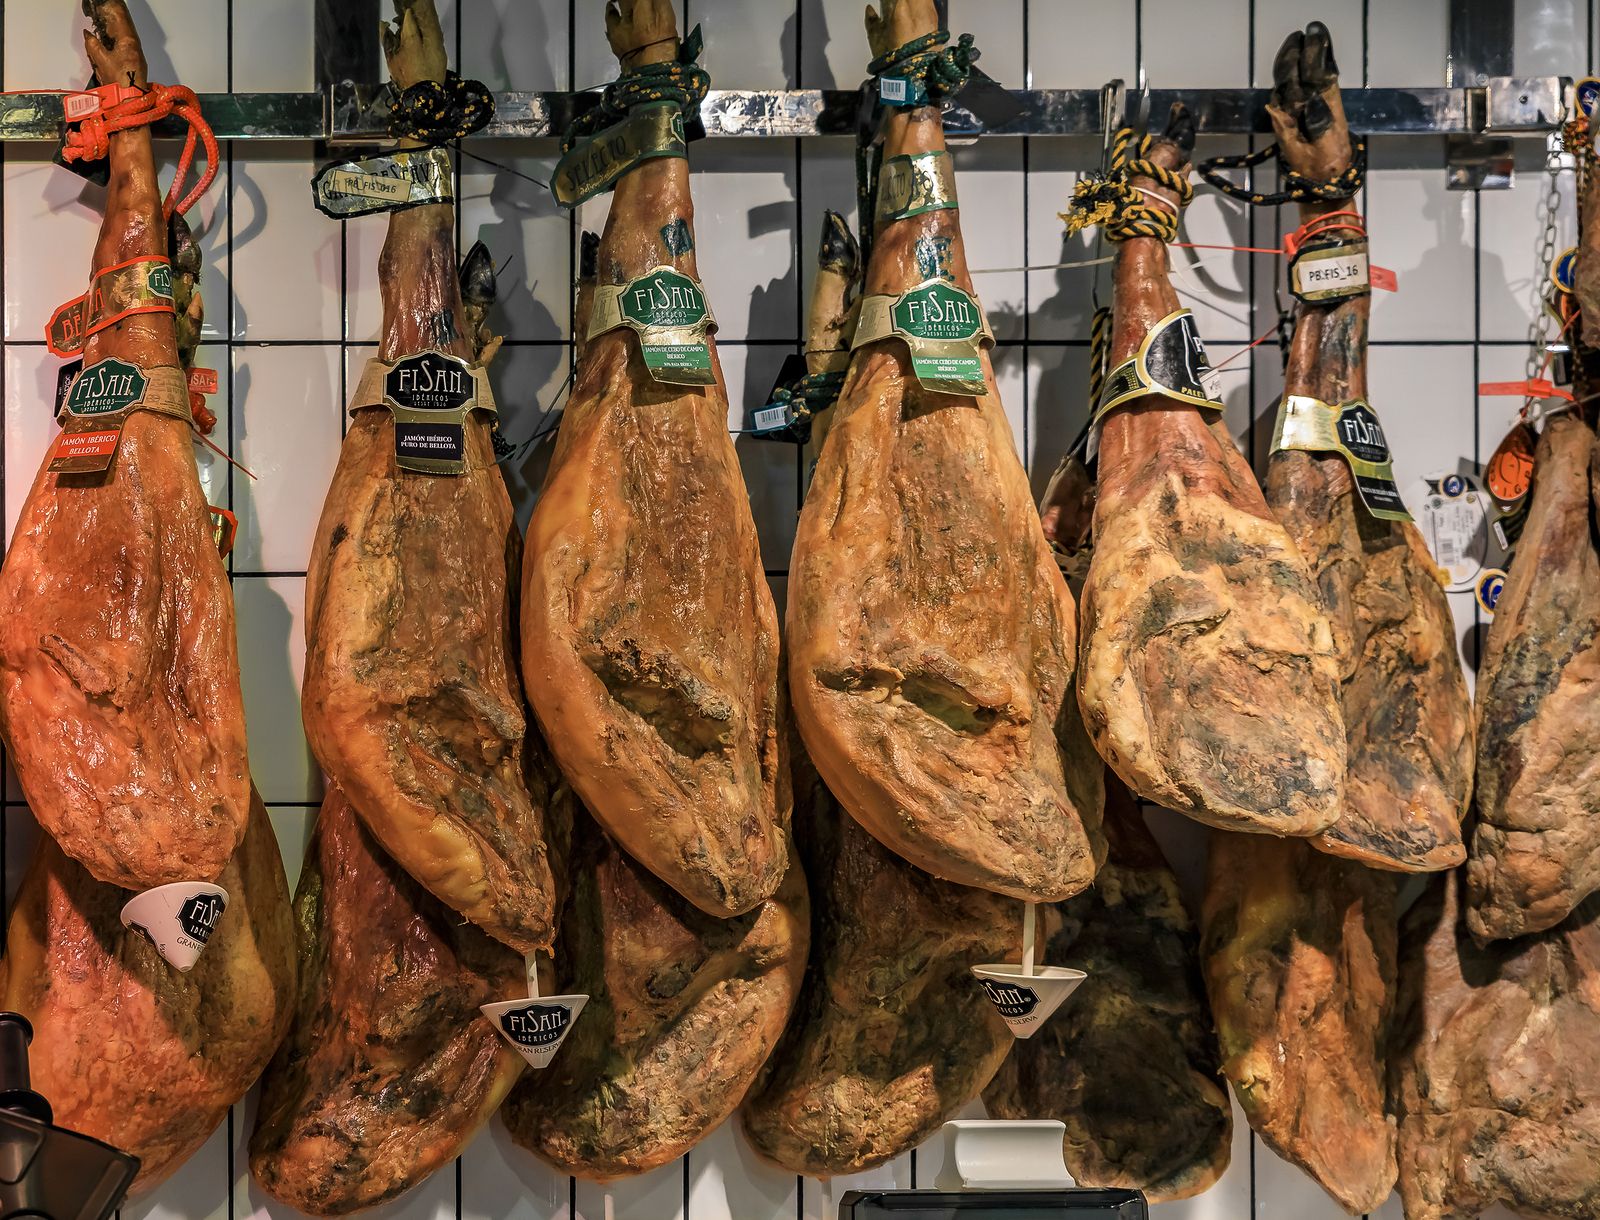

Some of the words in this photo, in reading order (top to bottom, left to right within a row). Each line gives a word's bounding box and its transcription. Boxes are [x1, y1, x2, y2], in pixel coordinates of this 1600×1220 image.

[154, 269, 171, 288] FIS
[634, 278, 698, 312] FISAN
[907, 291, 971, 323] FISAN
[75, 367, 135, 401] FISAN
[398, 360, 463, 394] FISAN
[61, 435, 87, 447] JAMÓN
[87, 434, 117, 445] IBÉRICO
[403, 434, 426, 442] JAMÓN
[426, 434, 453, 443] IBÉRICO
[1343, 411, 1386, 448] FISAN
[68, 446, 101, 455] BELLOTA
[400, 441, 418, 449] PURO
[429, 442, 457, 450] BELLOTA
[189, 899, 222, 929] FISA
[176, 936, 198, 951] GRAN
[980, 981, 1025, 1005] ISAN
[509, 1009, 562, 1033] FISAN
